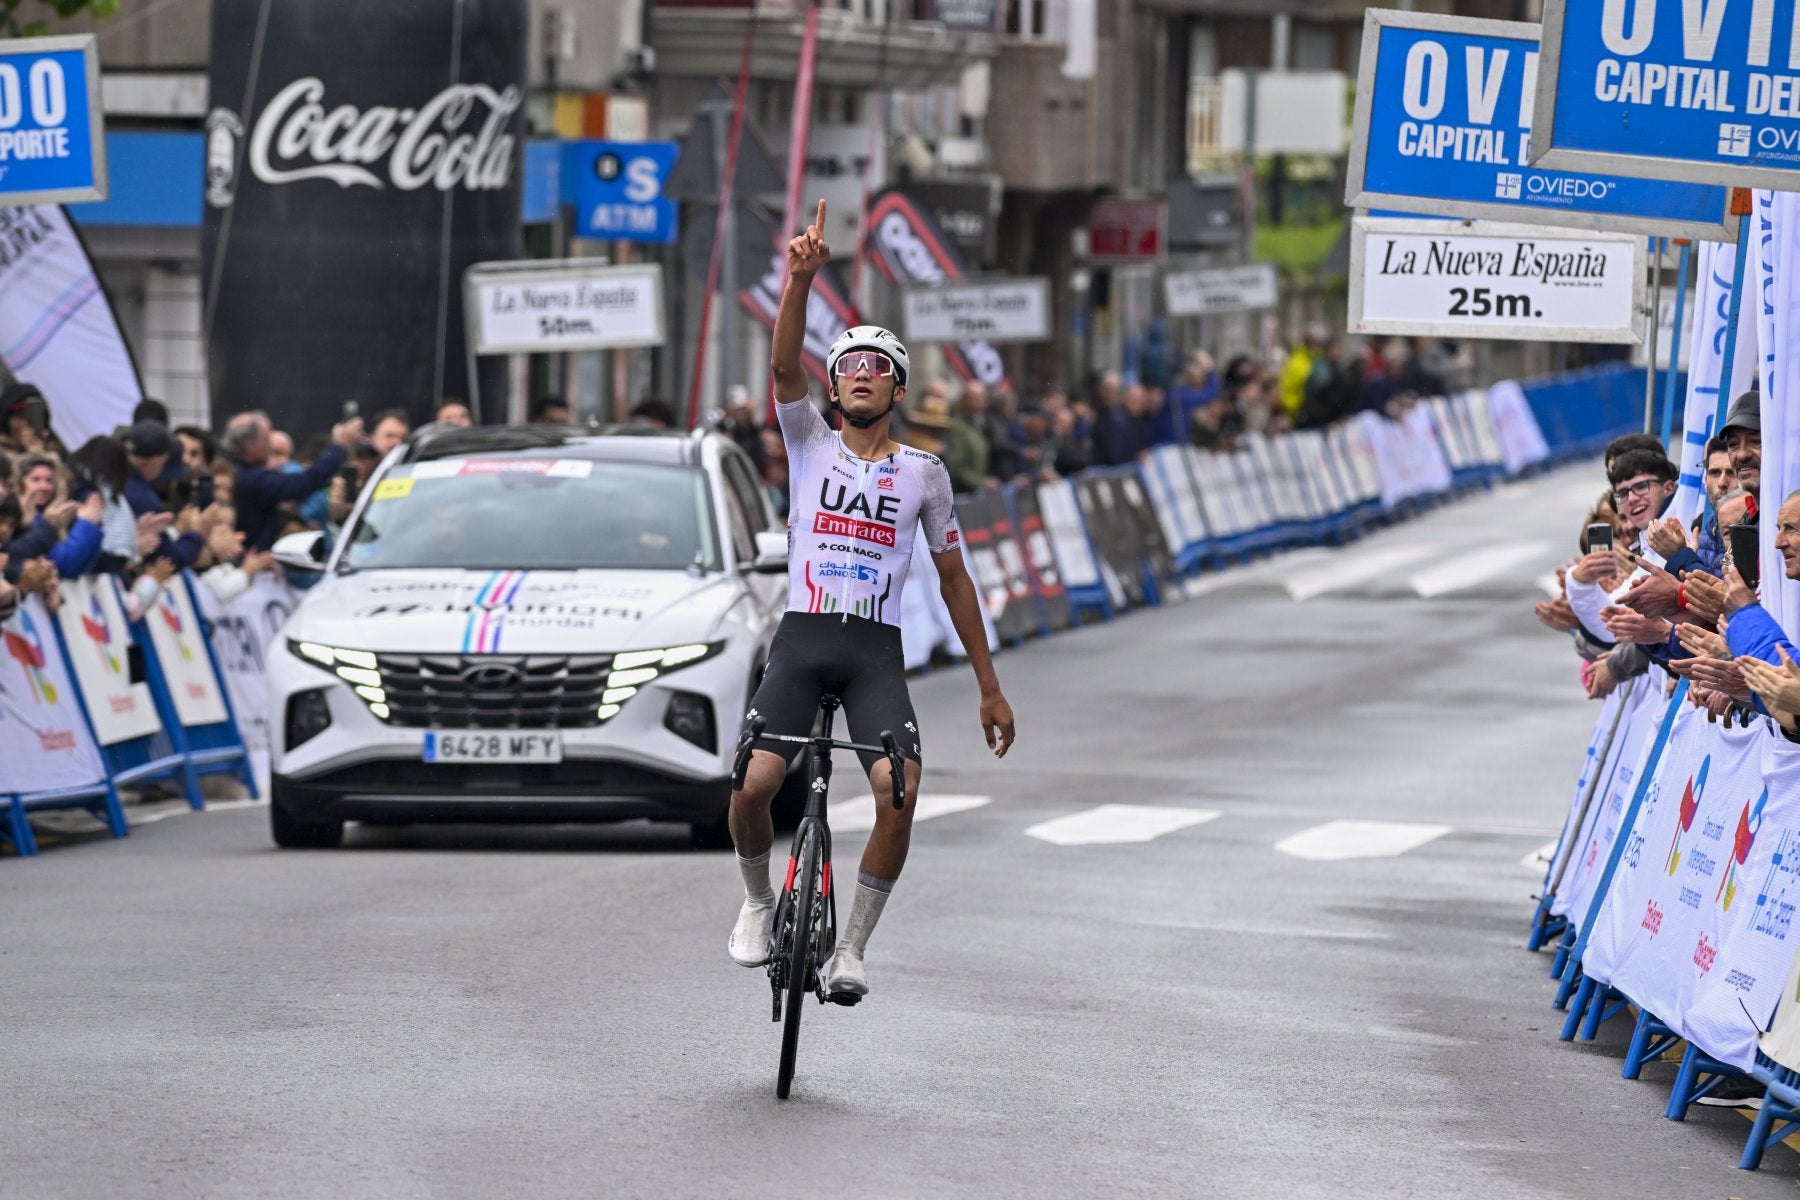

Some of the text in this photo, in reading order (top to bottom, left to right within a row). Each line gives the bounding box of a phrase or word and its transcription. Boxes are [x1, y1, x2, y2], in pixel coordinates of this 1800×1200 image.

[1595, 59, 1735, 112] CAPITAL
[0, 127, 70, 161] PORTE
[250, 76, 522, 190] Coca-Cola
[1398, 121, 1509, 165] CAPITAL
[590, 203, 658, 233] ATM
[1380, 241, 1607, 284] La Nueva España
[1448, 288, 1543, 318] 25m.
[820, 477, 901, 525] UAE
[816, 515, 893, 544] Emirates
[830, 544, 882, 560] COLNAGO
[819, 570, 857, 578] ADNOC
[440, 735, 501, 758] 6428
